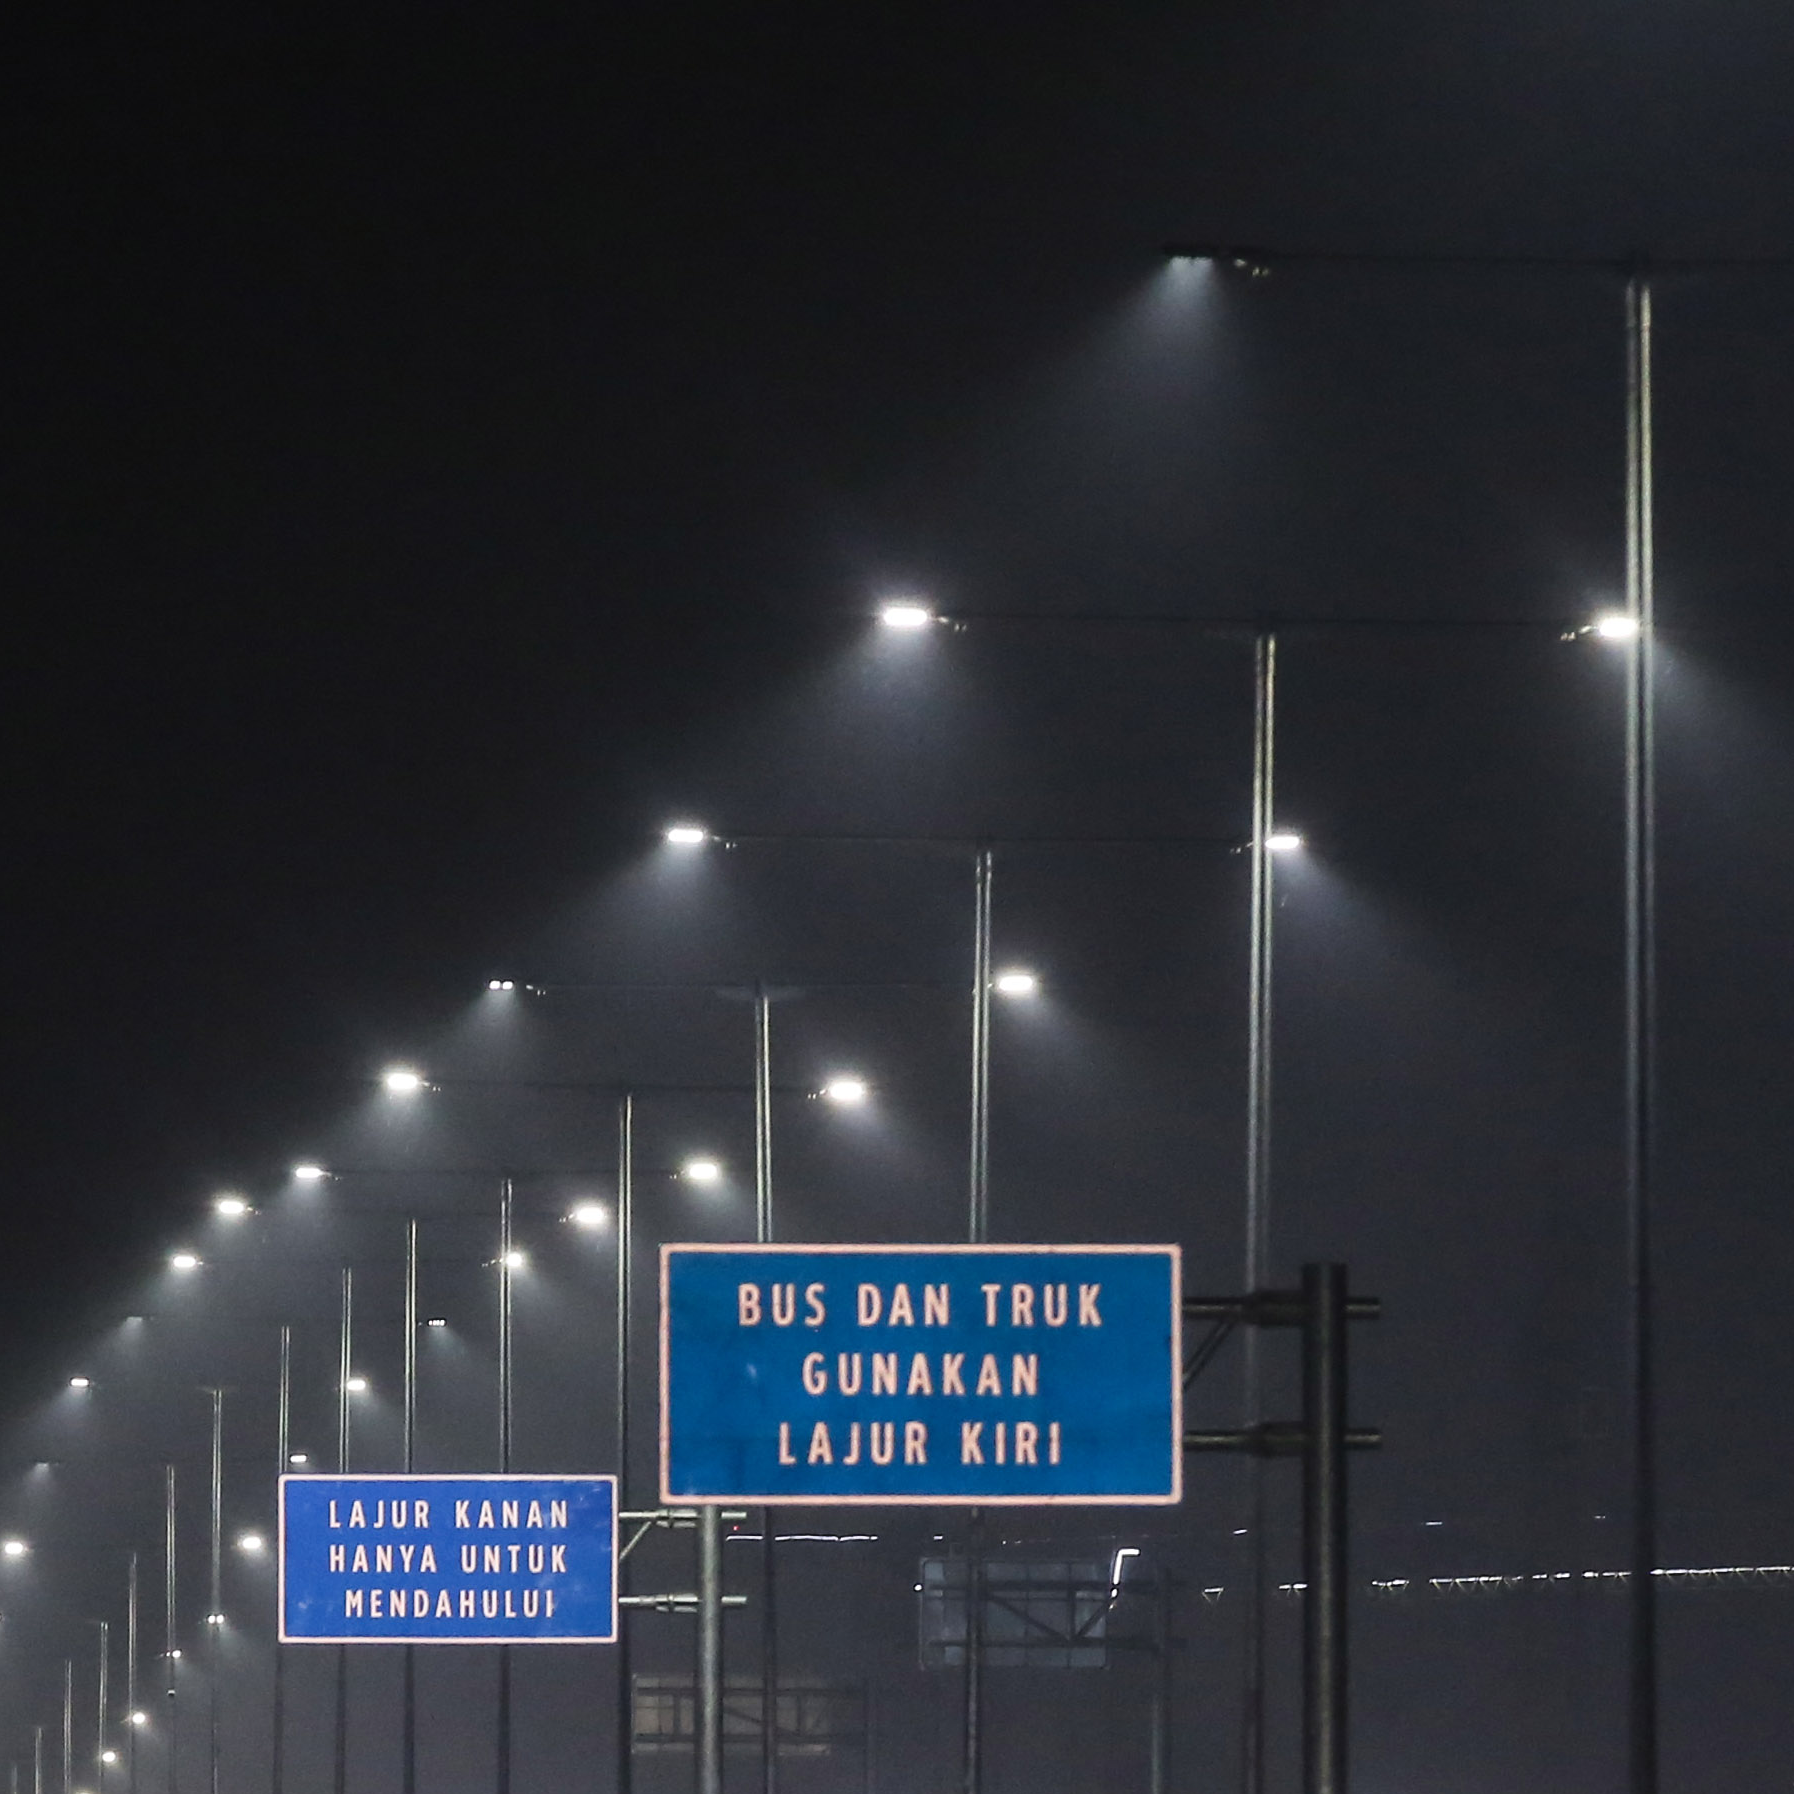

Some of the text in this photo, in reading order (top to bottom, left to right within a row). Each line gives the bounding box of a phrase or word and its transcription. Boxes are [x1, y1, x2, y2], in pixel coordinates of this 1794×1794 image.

[739, 1283, 1101, 1327] BUS DAN TRUK
[803, 1352, 1037, 1396] GUNAKAN
[779, 1421, 1060, 1465] LAJUR KIRI
[330, 1500, 567, 1528] LAJUR KANAN
[330, 1544, 566, 1573] HANYA UNTUK
[346, 1589, 554, 1618] MENDAHULUI
